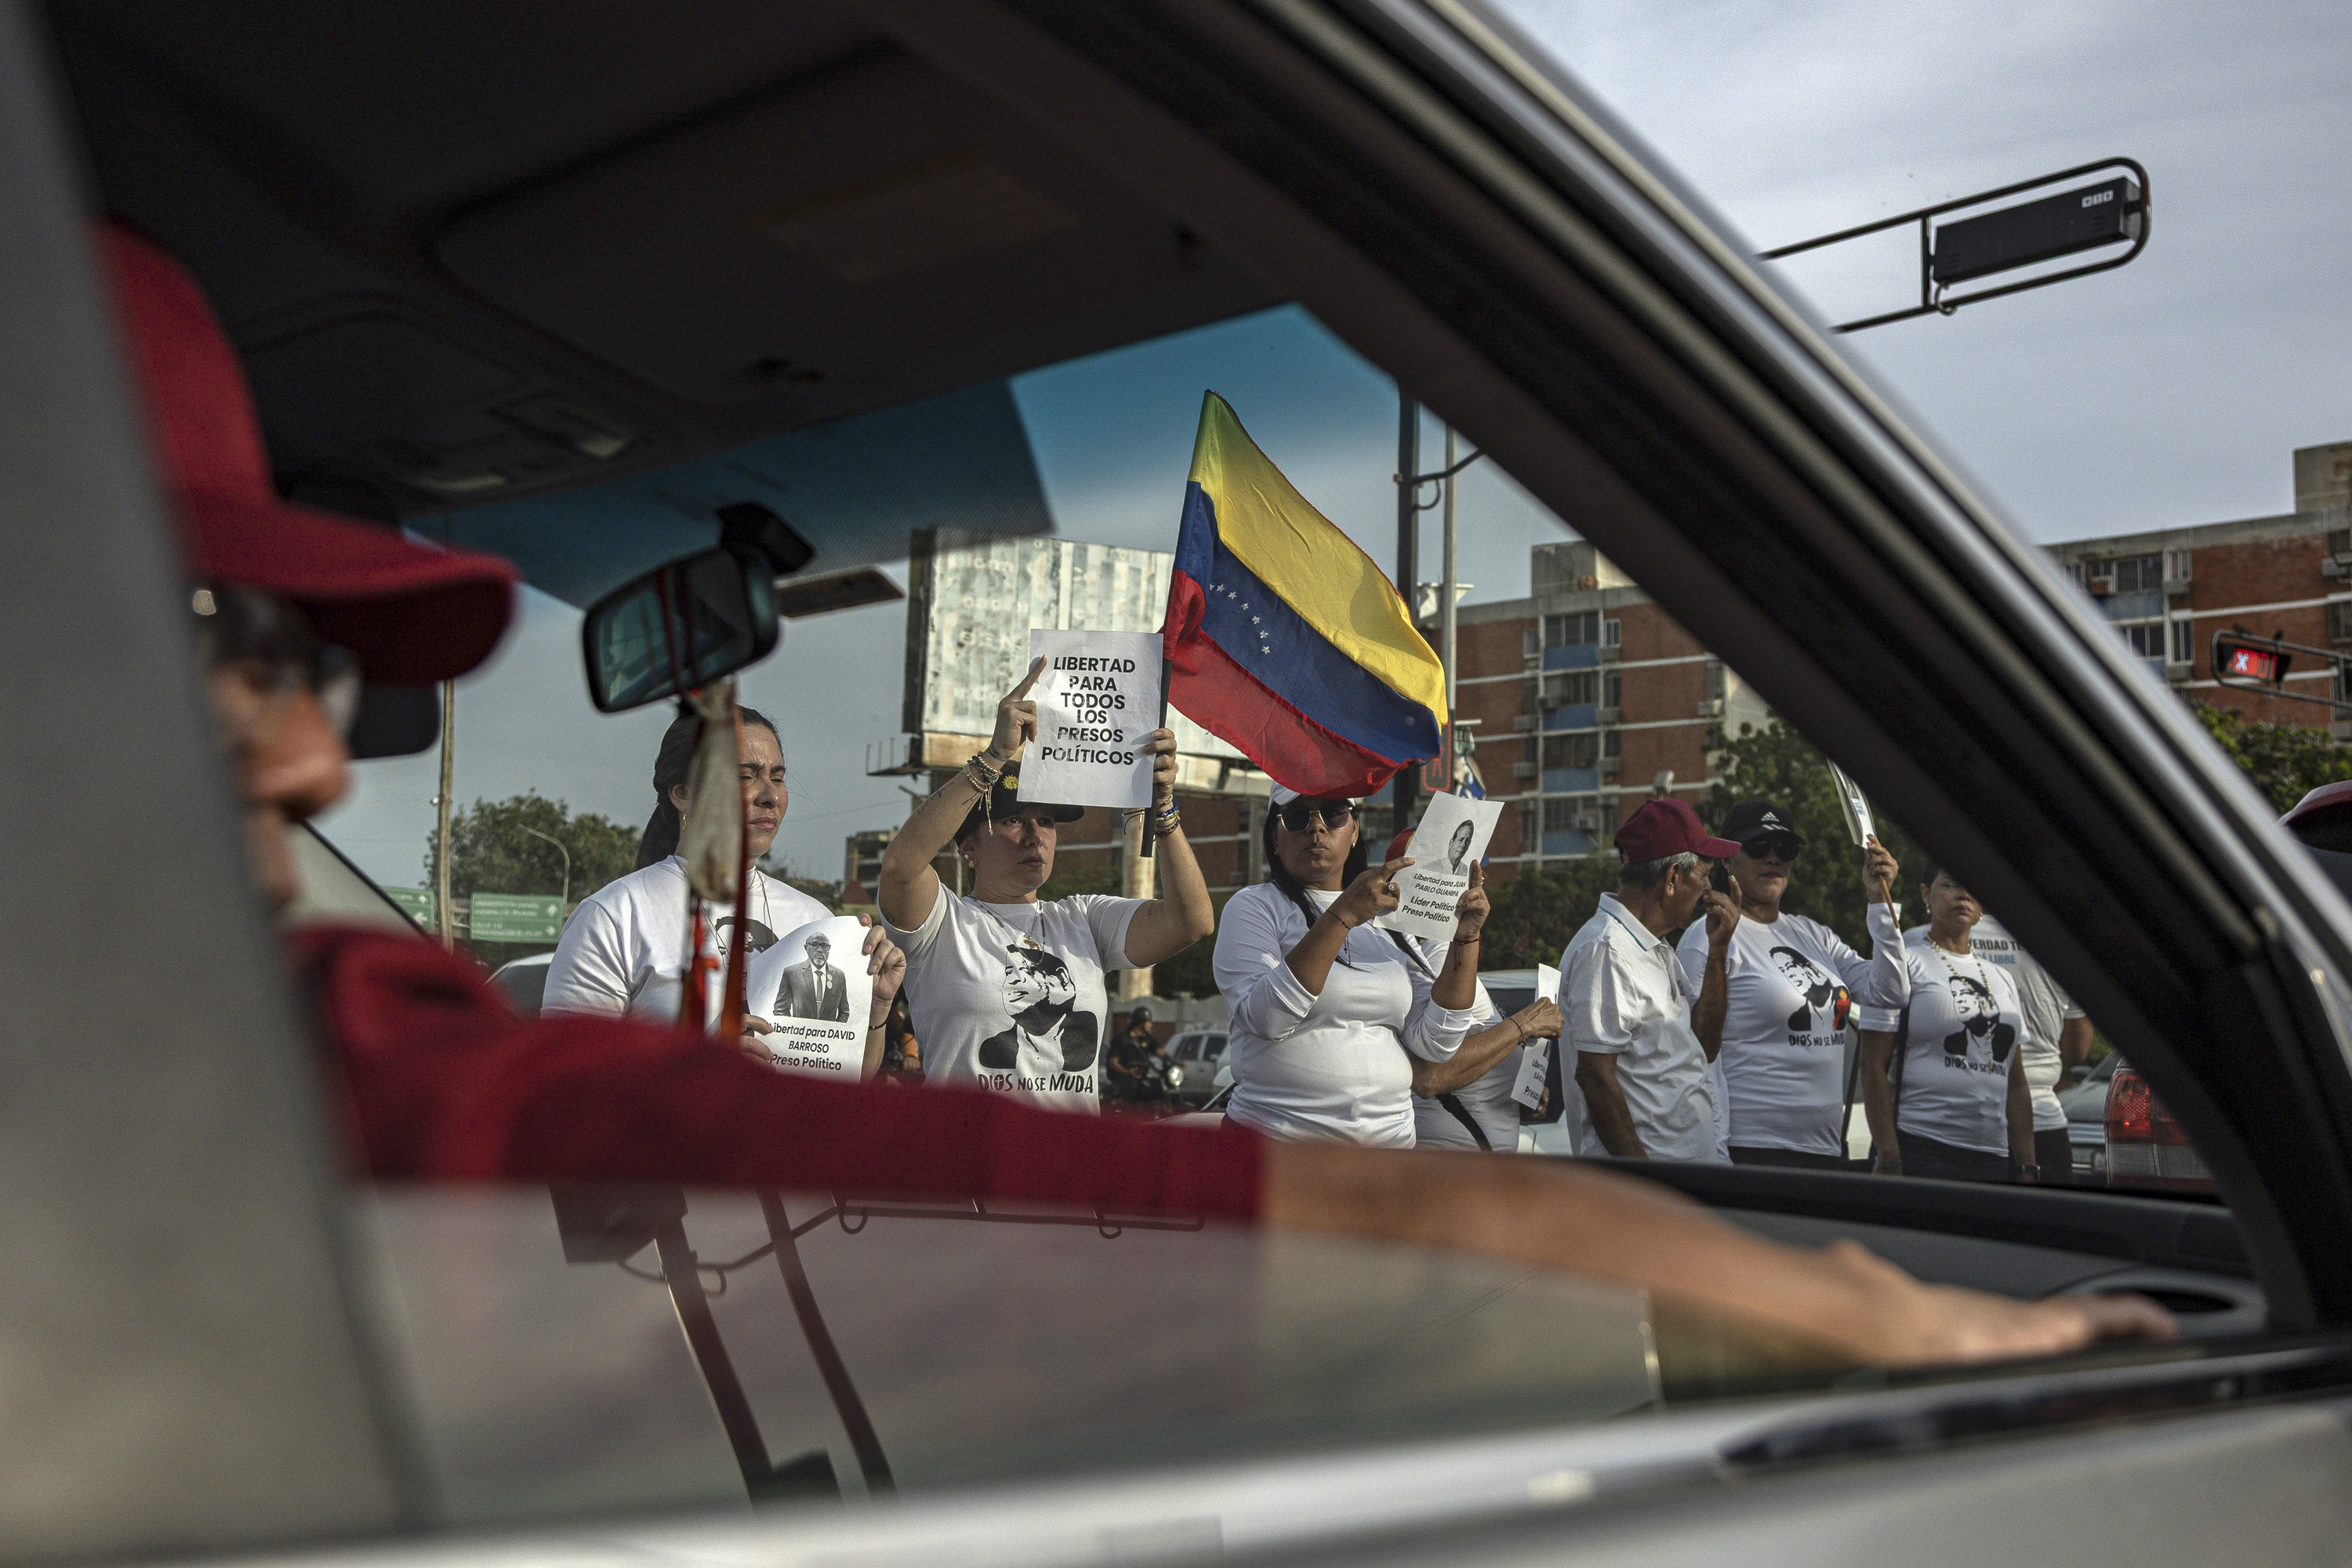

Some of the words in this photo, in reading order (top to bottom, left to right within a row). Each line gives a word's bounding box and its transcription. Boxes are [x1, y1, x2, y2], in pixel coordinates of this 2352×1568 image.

[1053, 656, 1136, 673] LIBERTAD
[1069, 675, 1117, 691] PARA
[1060, 692, 1126, 710] TODOS
[1076, 710, 1107, 724] LOS
[1057, 727, 1123, 742] PRESOS
[1041, 745, 1134, 765] POLÍTICOS
[1414, 873, 1441, 884] Libertad
[1414, 883, 1436, 893] PABLO
[1436, 888, 1459, 898] GUANIPA
[1410, 896, 1431, 907] Líder
[1429, 901, 1455, 912] Político
[1401, 905, 1424, 916] Preso
[1423, 911, 1450, 923] Político
[1989, 953, 2016, 964] LIBRE
[769, 1022, 805, 1036] ibertad
[804, 1028, 826, 1040] para
[827, 1029, 855, 1040] DAVID
[788, 1040, 829, 1053] BARROSO
[1788, 1033, 1812, 1047] DIOS
[1813, 1036, 1823, 1047] NO
[770, 1054, 800, 1066] Preso
[802, 1056, 842, 1071] Político
[1944, 1056, 1966, 1069] DIOS
[978, 1073, 1013, 1092] DIOS
[1018, 1076, 1033, 1091] NO
[1035, 1076, 1046, 1091] SE
[1049, 1073, 1094, 1094] MUDA
